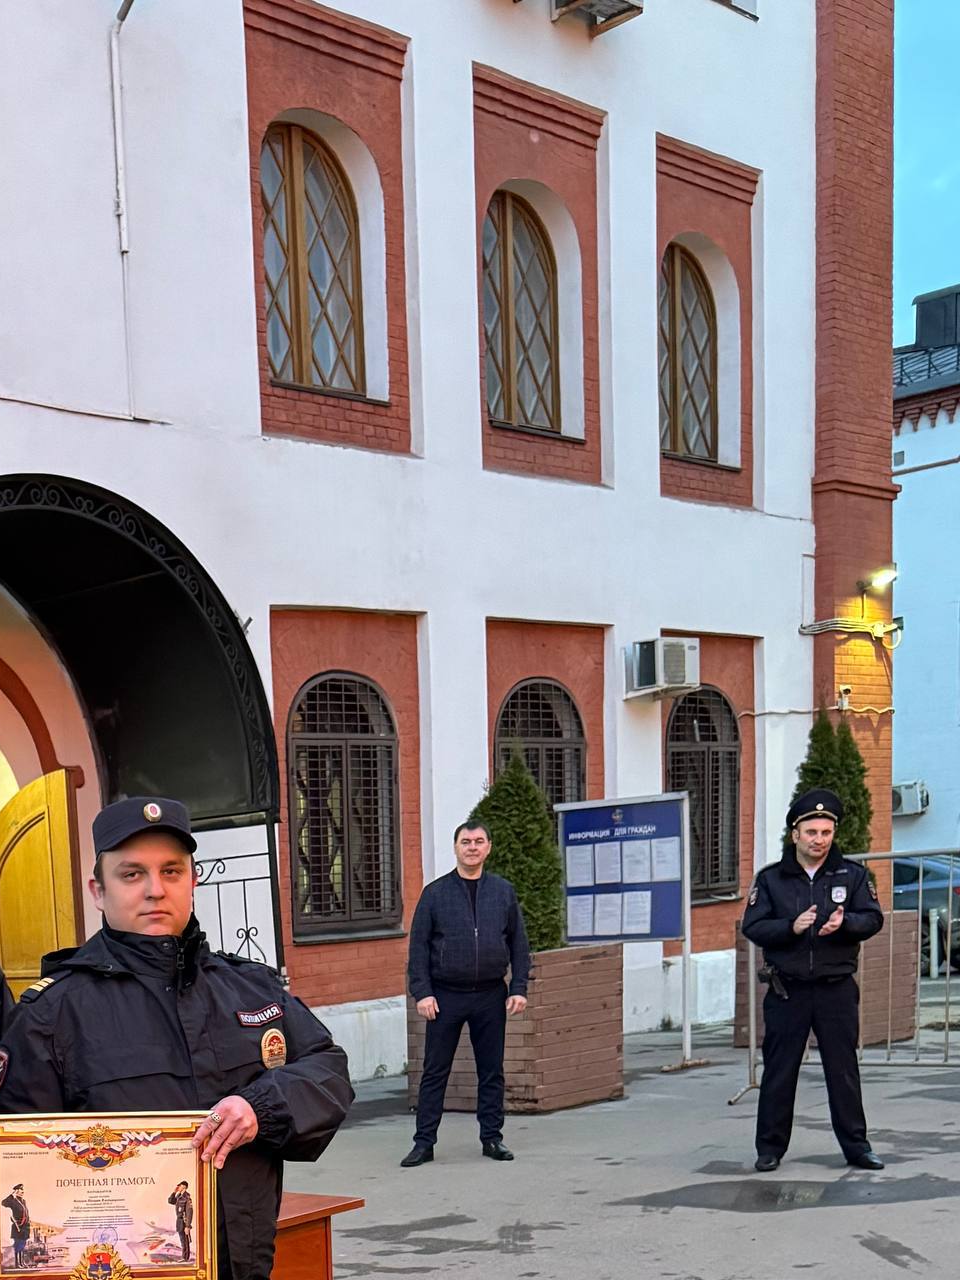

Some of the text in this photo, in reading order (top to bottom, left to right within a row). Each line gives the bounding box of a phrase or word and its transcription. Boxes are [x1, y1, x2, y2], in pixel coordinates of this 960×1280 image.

[568, 824, 656, 840] ИНФОРМАЦИЯ ДЛЯ ГРАЖДАН
[240, 1006, 280, 1023] ПОЛИЦИЯ
[56, 1177, 155, 1187] ПОЧЕТНАЯ ГРАМОТА
